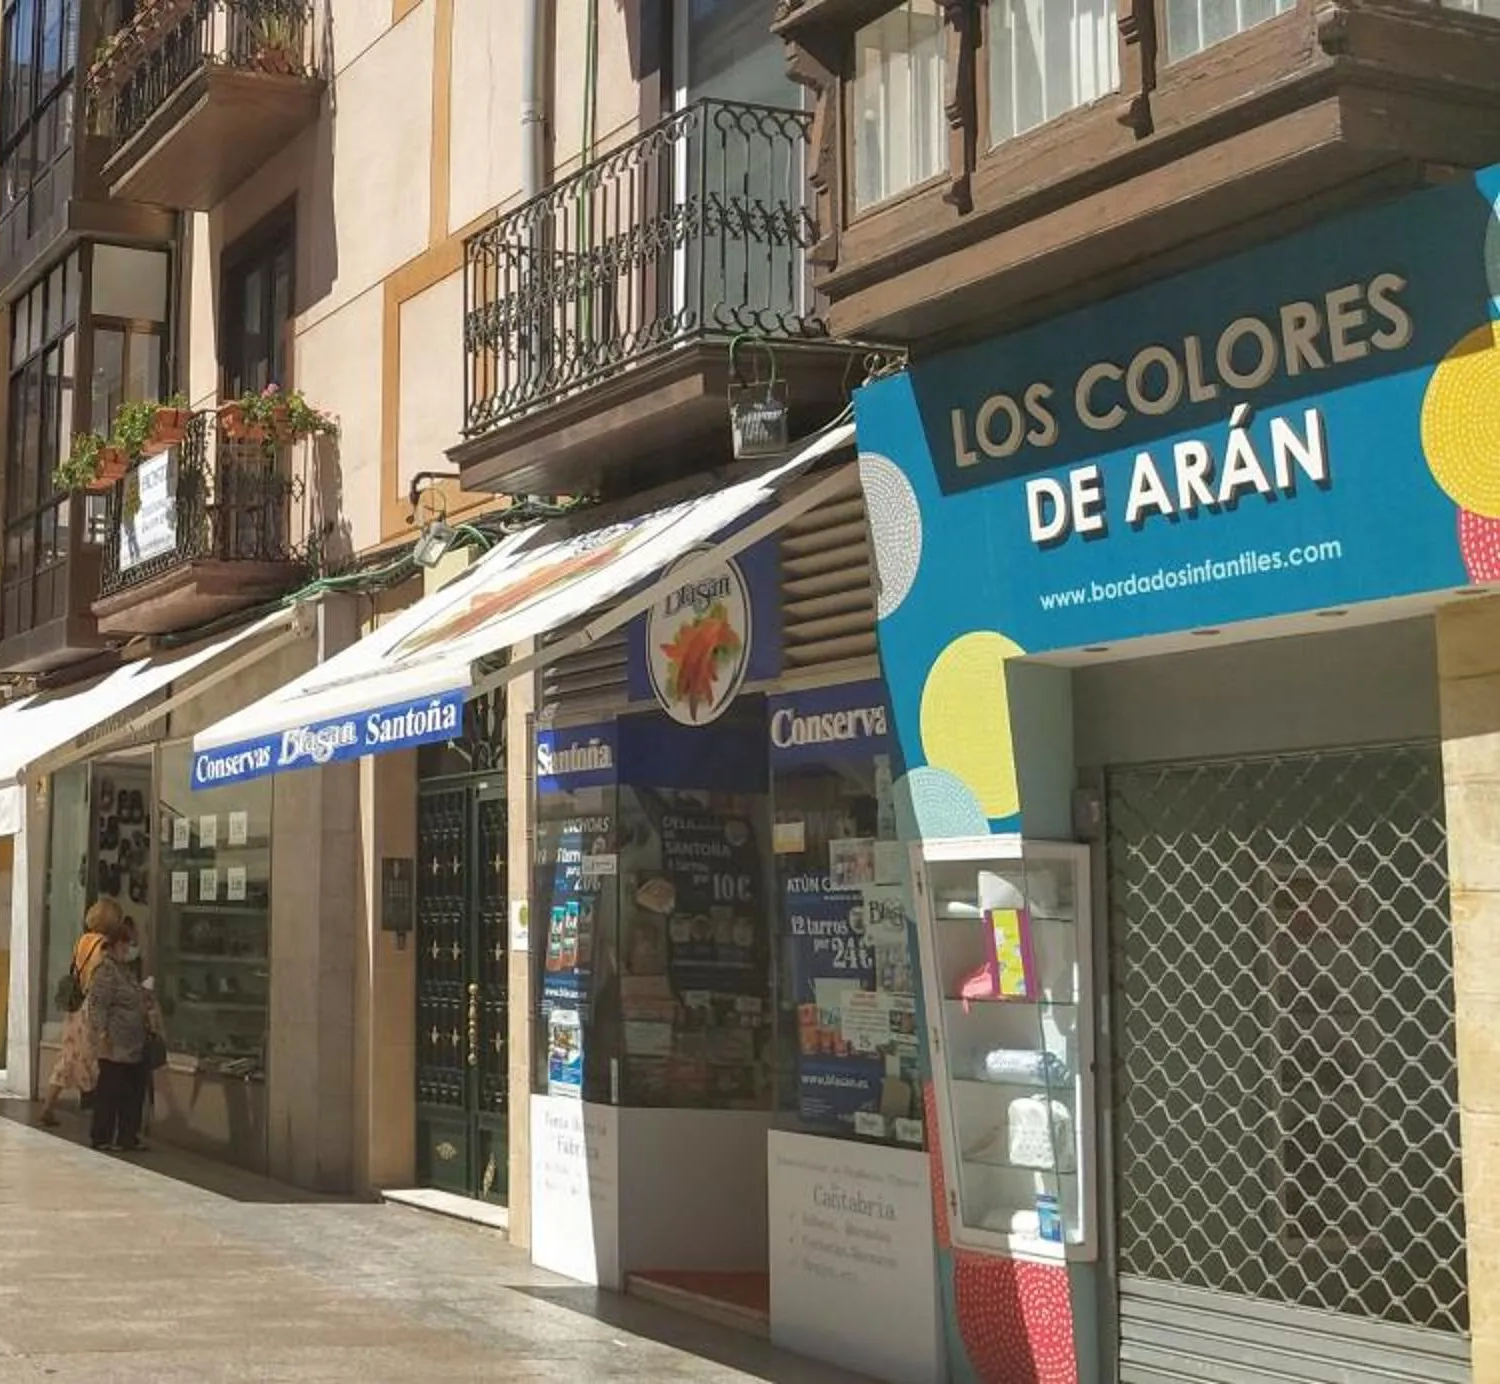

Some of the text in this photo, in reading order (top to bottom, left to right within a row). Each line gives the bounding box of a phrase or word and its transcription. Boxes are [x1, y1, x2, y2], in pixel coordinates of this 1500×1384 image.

[950, 272, 1414, 468] LOS COLORES
[1025, 404, 1330, 546] DE ARÁN
[1040, 537, 1343, 611] www.bordadosinfantiles.com
[195, 699, 456, 784] Conservas Blasan Santoña
[537, 737, 613, 776] Santoña
